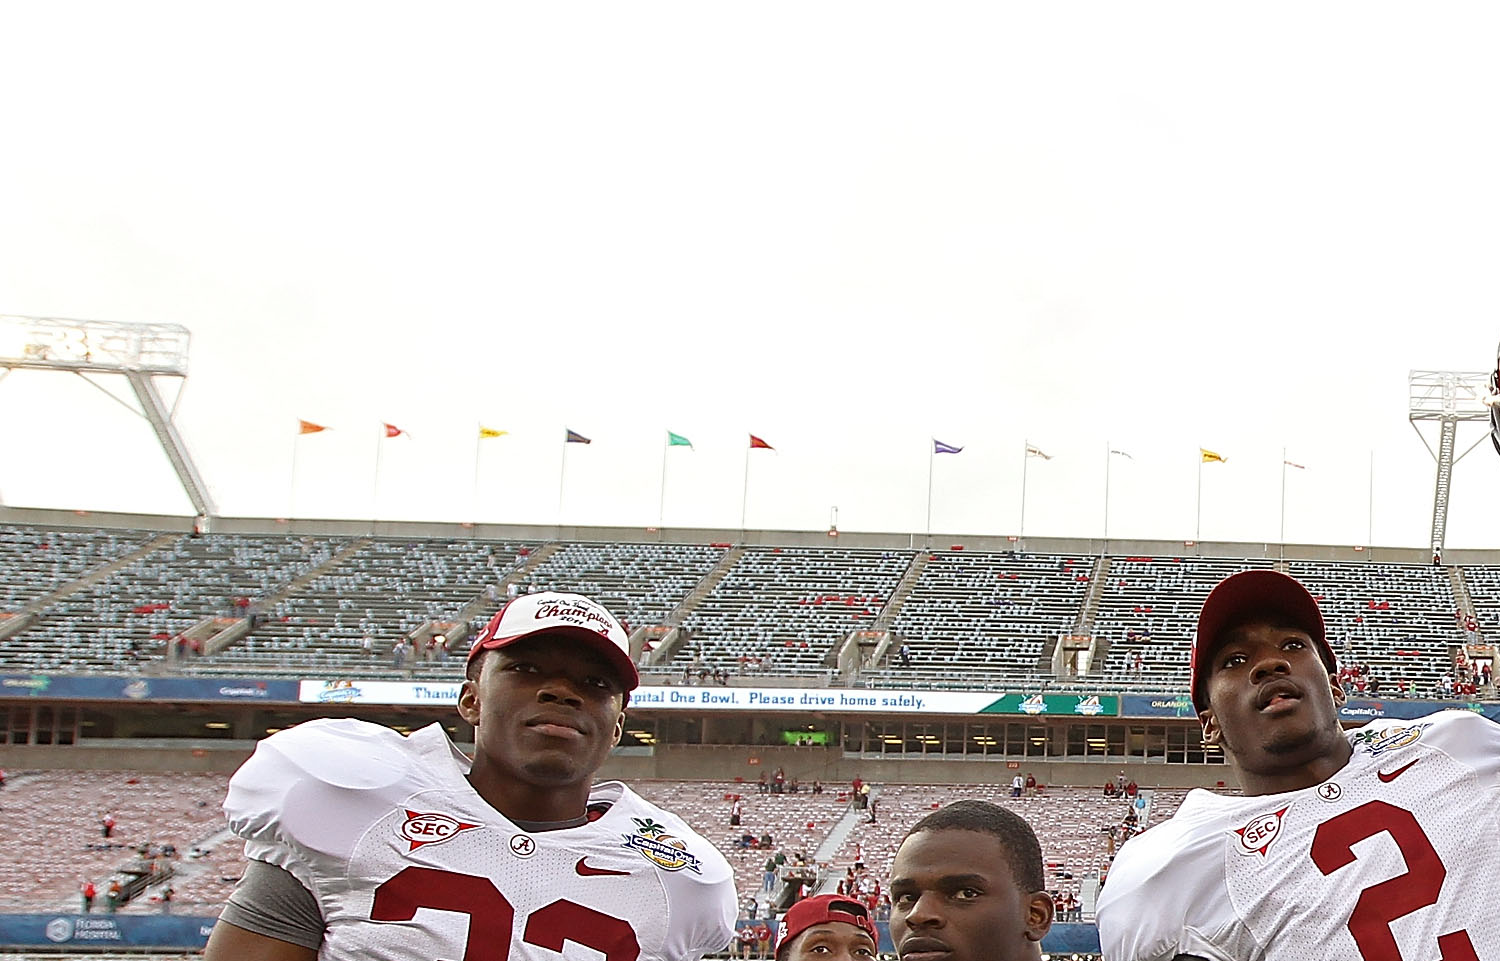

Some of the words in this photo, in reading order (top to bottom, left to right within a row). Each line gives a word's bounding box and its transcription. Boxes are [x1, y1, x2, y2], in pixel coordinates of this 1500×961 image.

[534, 604, 613, 629] Champions
[560, 616, 584, 625] 2011
[413, 686, 458, 699] Thank
[630, 691, 664, 705] pital
[670, 691, 695, 703] One
[701, 691, 739, 704] Bowl.
[748, 692, 795, 705] Please
[800, 693, 834, 706] drive
[840, 694, 877, 706] home
[882, 695, 926, 709] safely.
[1151, 700, 1188, 709] ORLANDO
[408, 821, 450, 838] SEC
[1246, 821, 1276, 844] SEC
